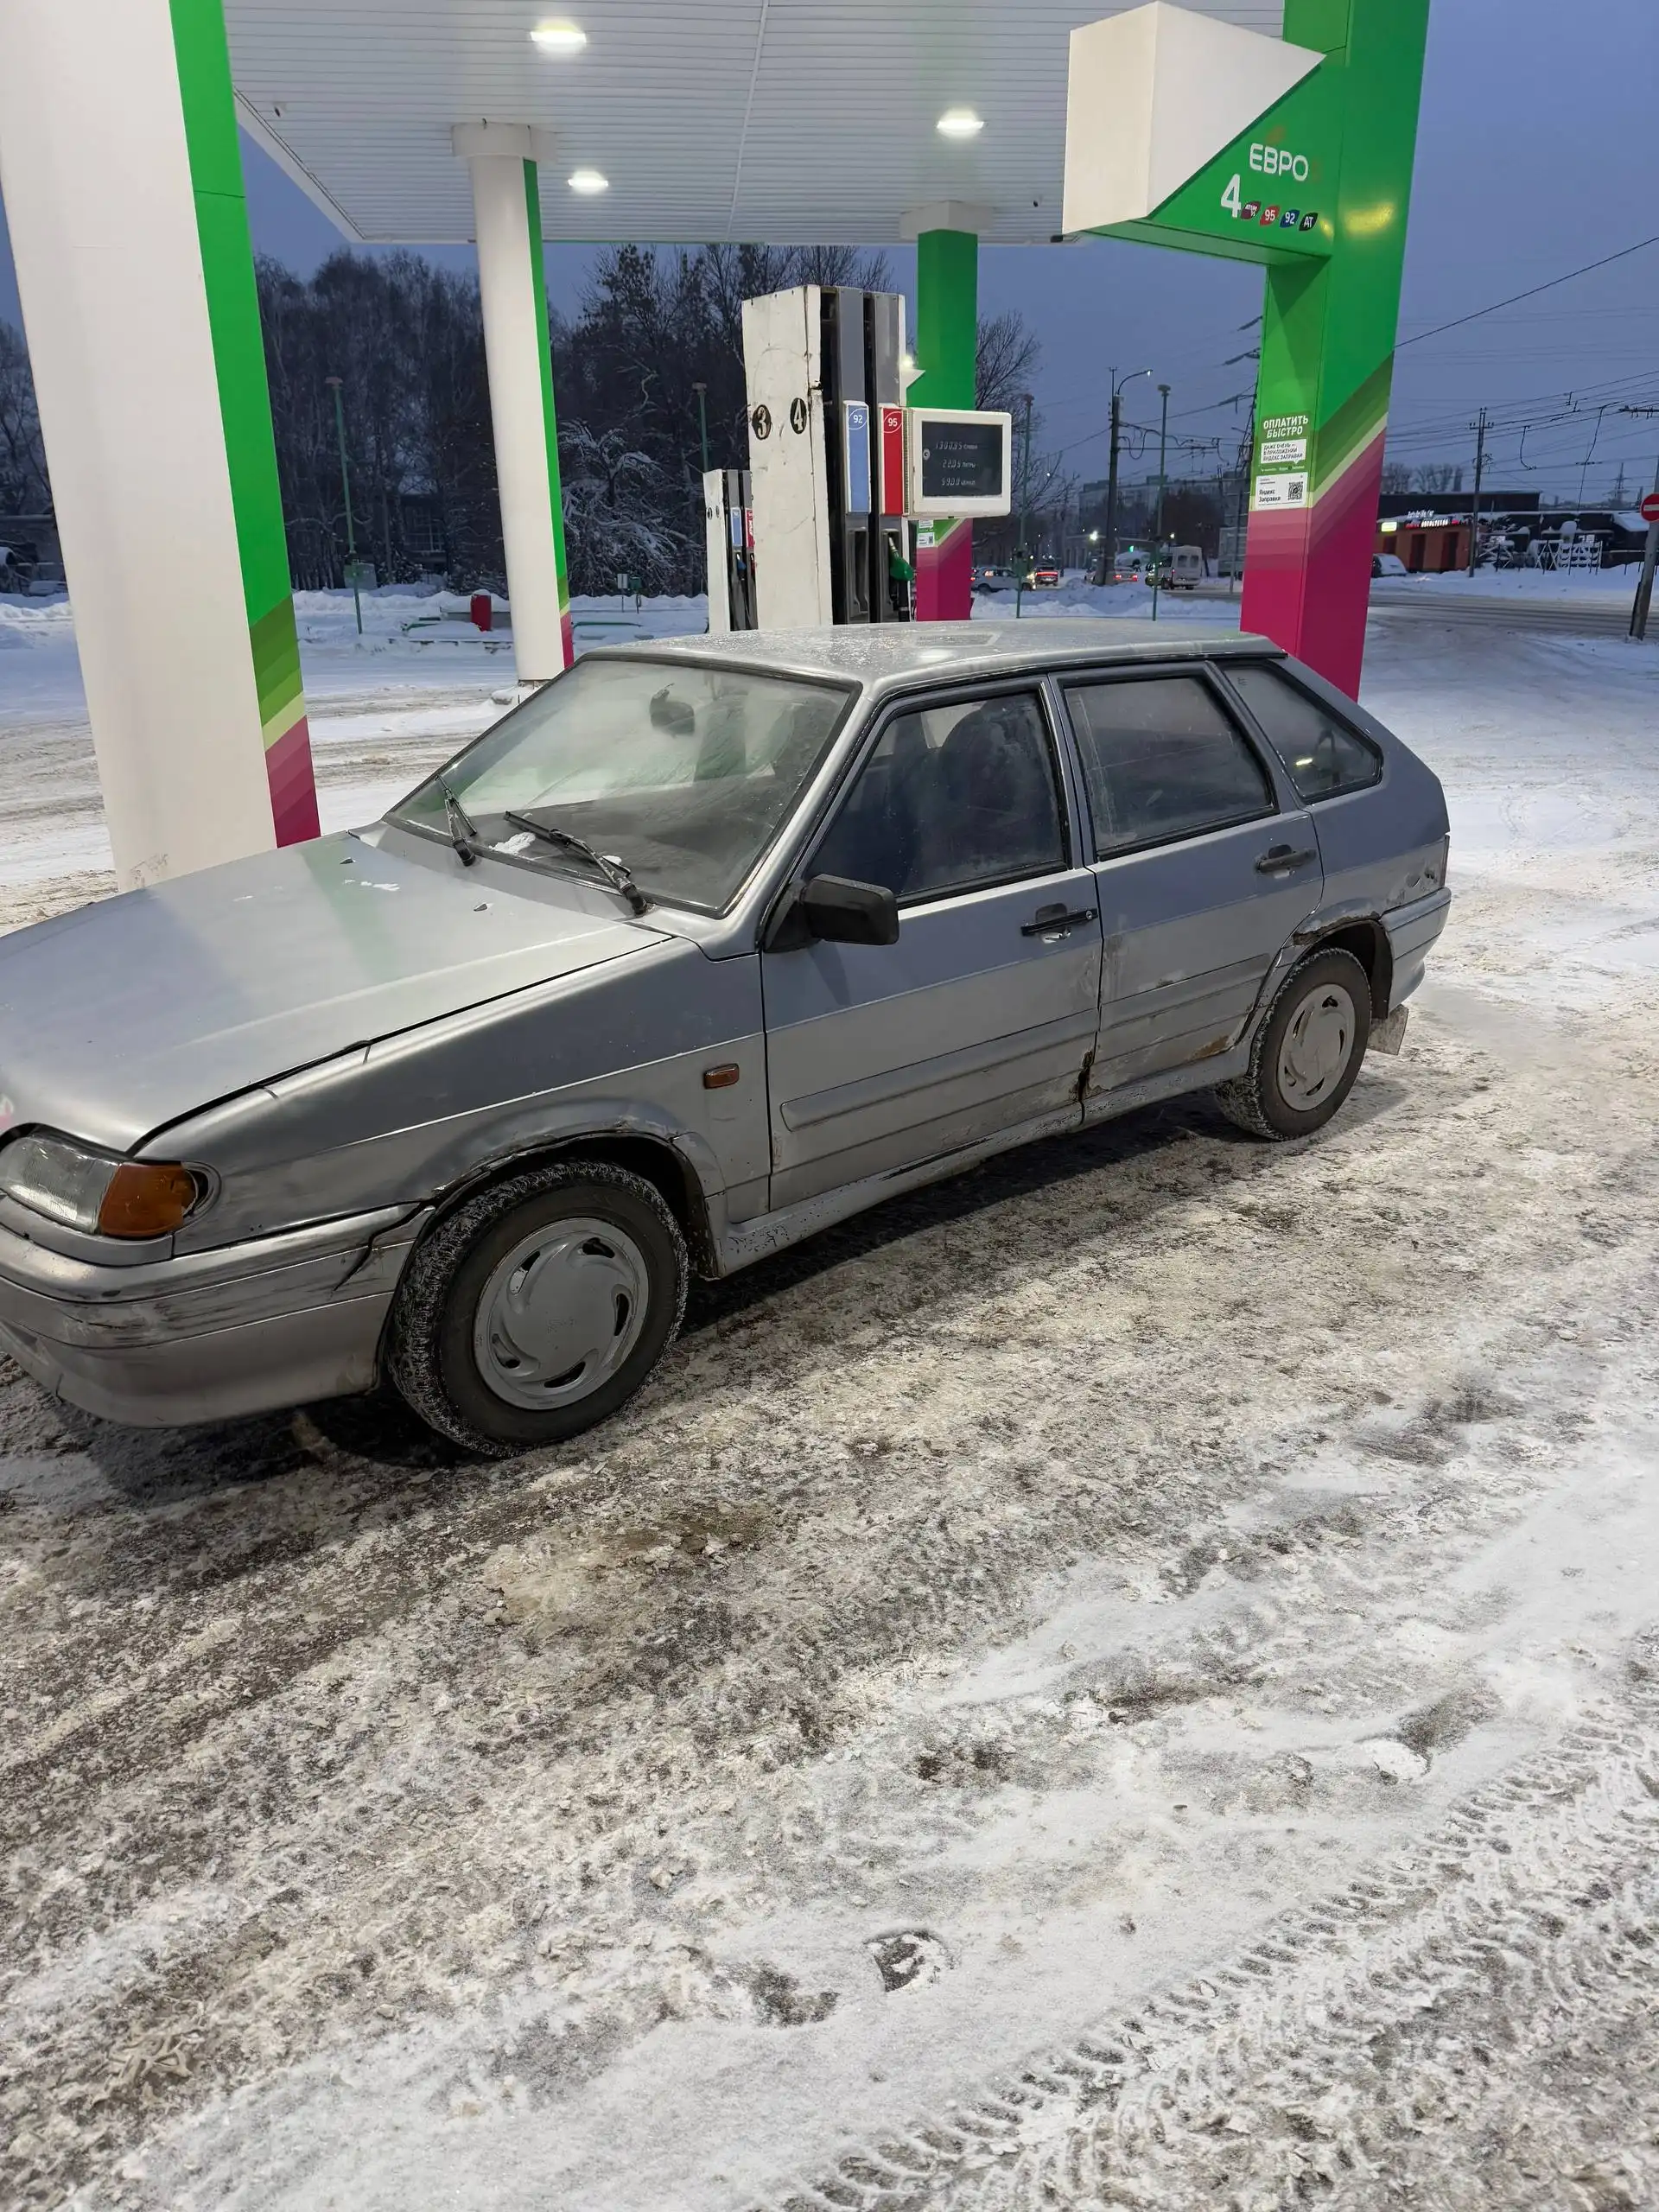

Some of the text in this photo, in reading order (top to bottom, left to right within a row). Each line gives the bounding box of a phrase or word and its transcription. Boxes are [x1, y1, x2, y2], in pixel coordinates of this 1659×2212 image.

[1249, 143, 1309, 181] ЕВРО
[1221, 174, 1242, 218] 4
[1265, 209, 1275, 221] 95
[1285, 212, 1295, 224] 92
[794, 399, 803, 431] 4
[853, 415, 863, 423] 92
[757, 407, 767, 438] 3
[887, 418, 898, 427] 95
[1264, 416, 1308, 429] ОПЛАТИТЬ
[1267, 426, 1303, 438] БЫСТРО
